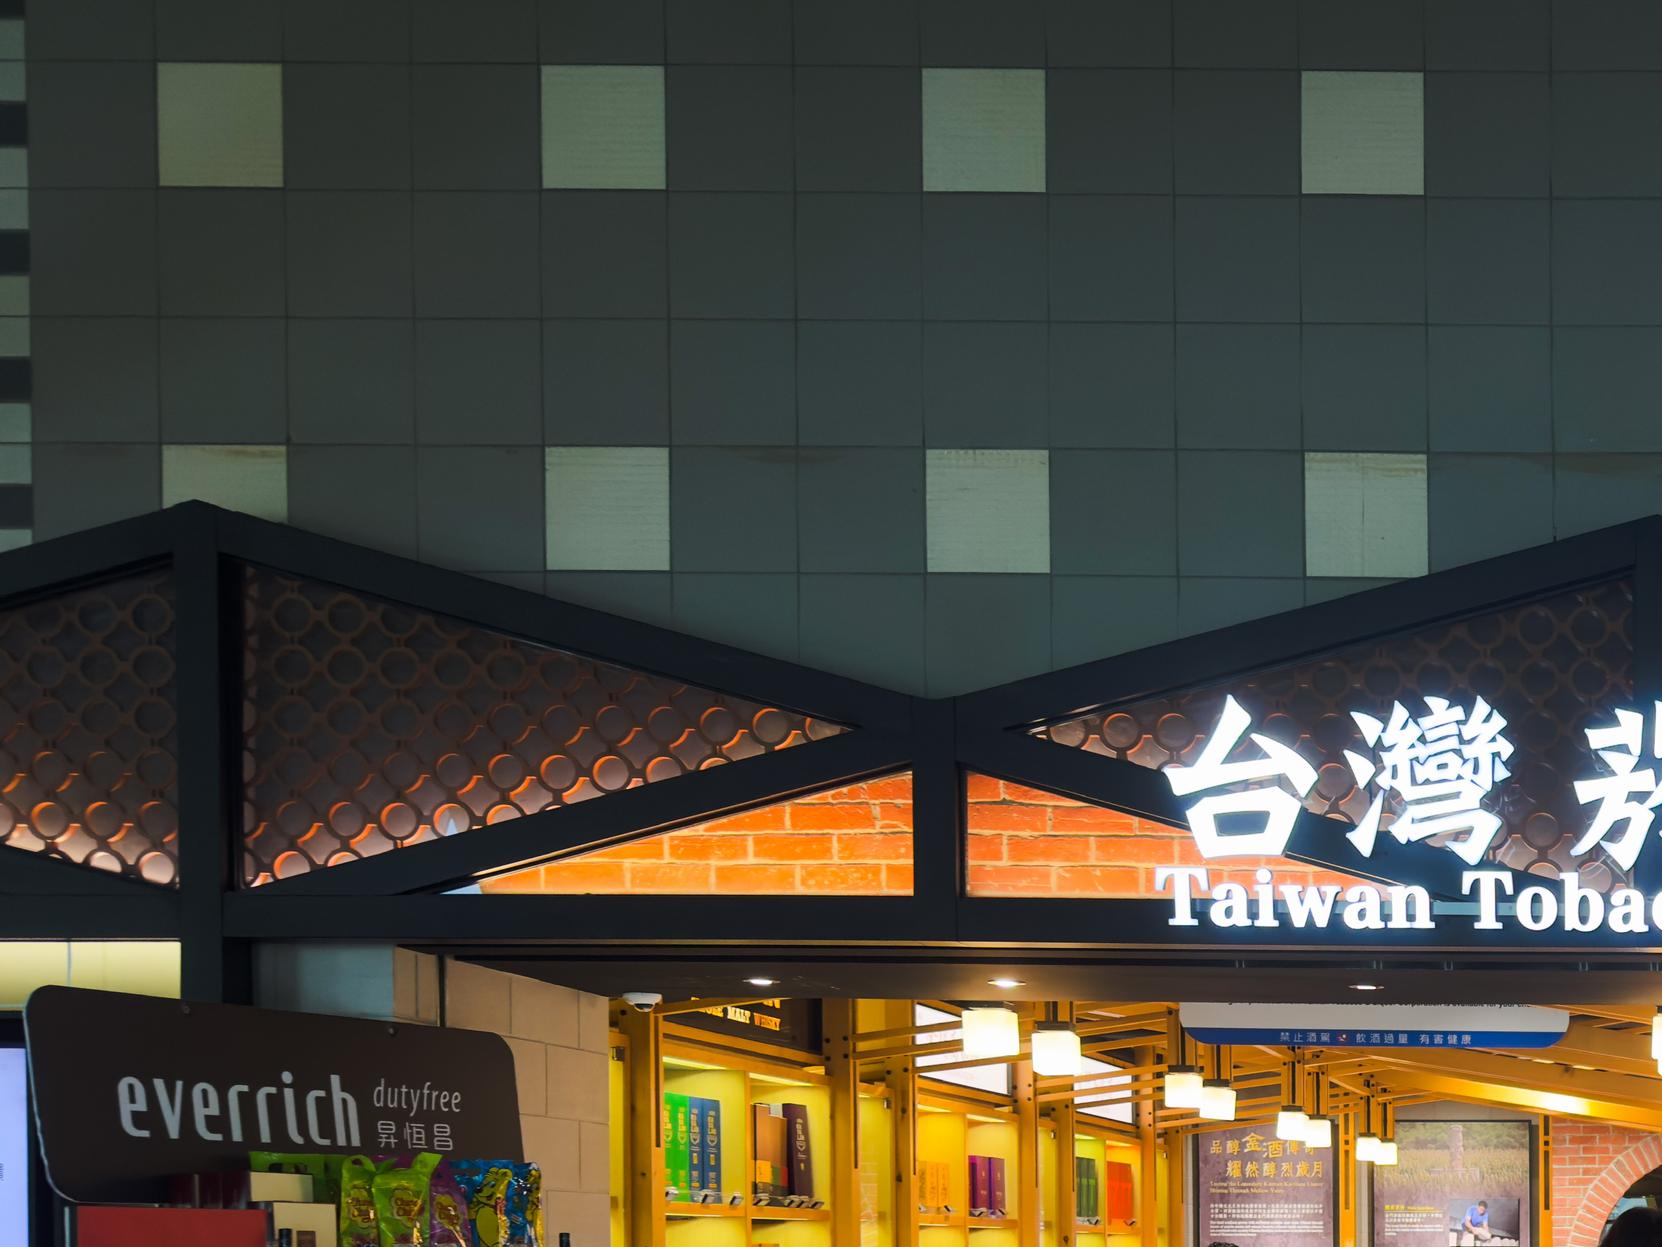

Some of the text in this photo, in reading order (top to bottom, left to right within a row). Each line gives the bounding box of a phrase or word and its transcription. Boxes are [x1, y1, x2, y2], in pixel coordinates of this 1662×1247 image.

[1155, 866, 1435, 931] Taiwan
[727, 1006, 751, 1024] MALT
[1356, 1033, 1408, 1044] 飲酒過量
[1419, 1034, 1472, 1045] 有害健康
[117, 1071, 462, 1147] everrich dutyfree
